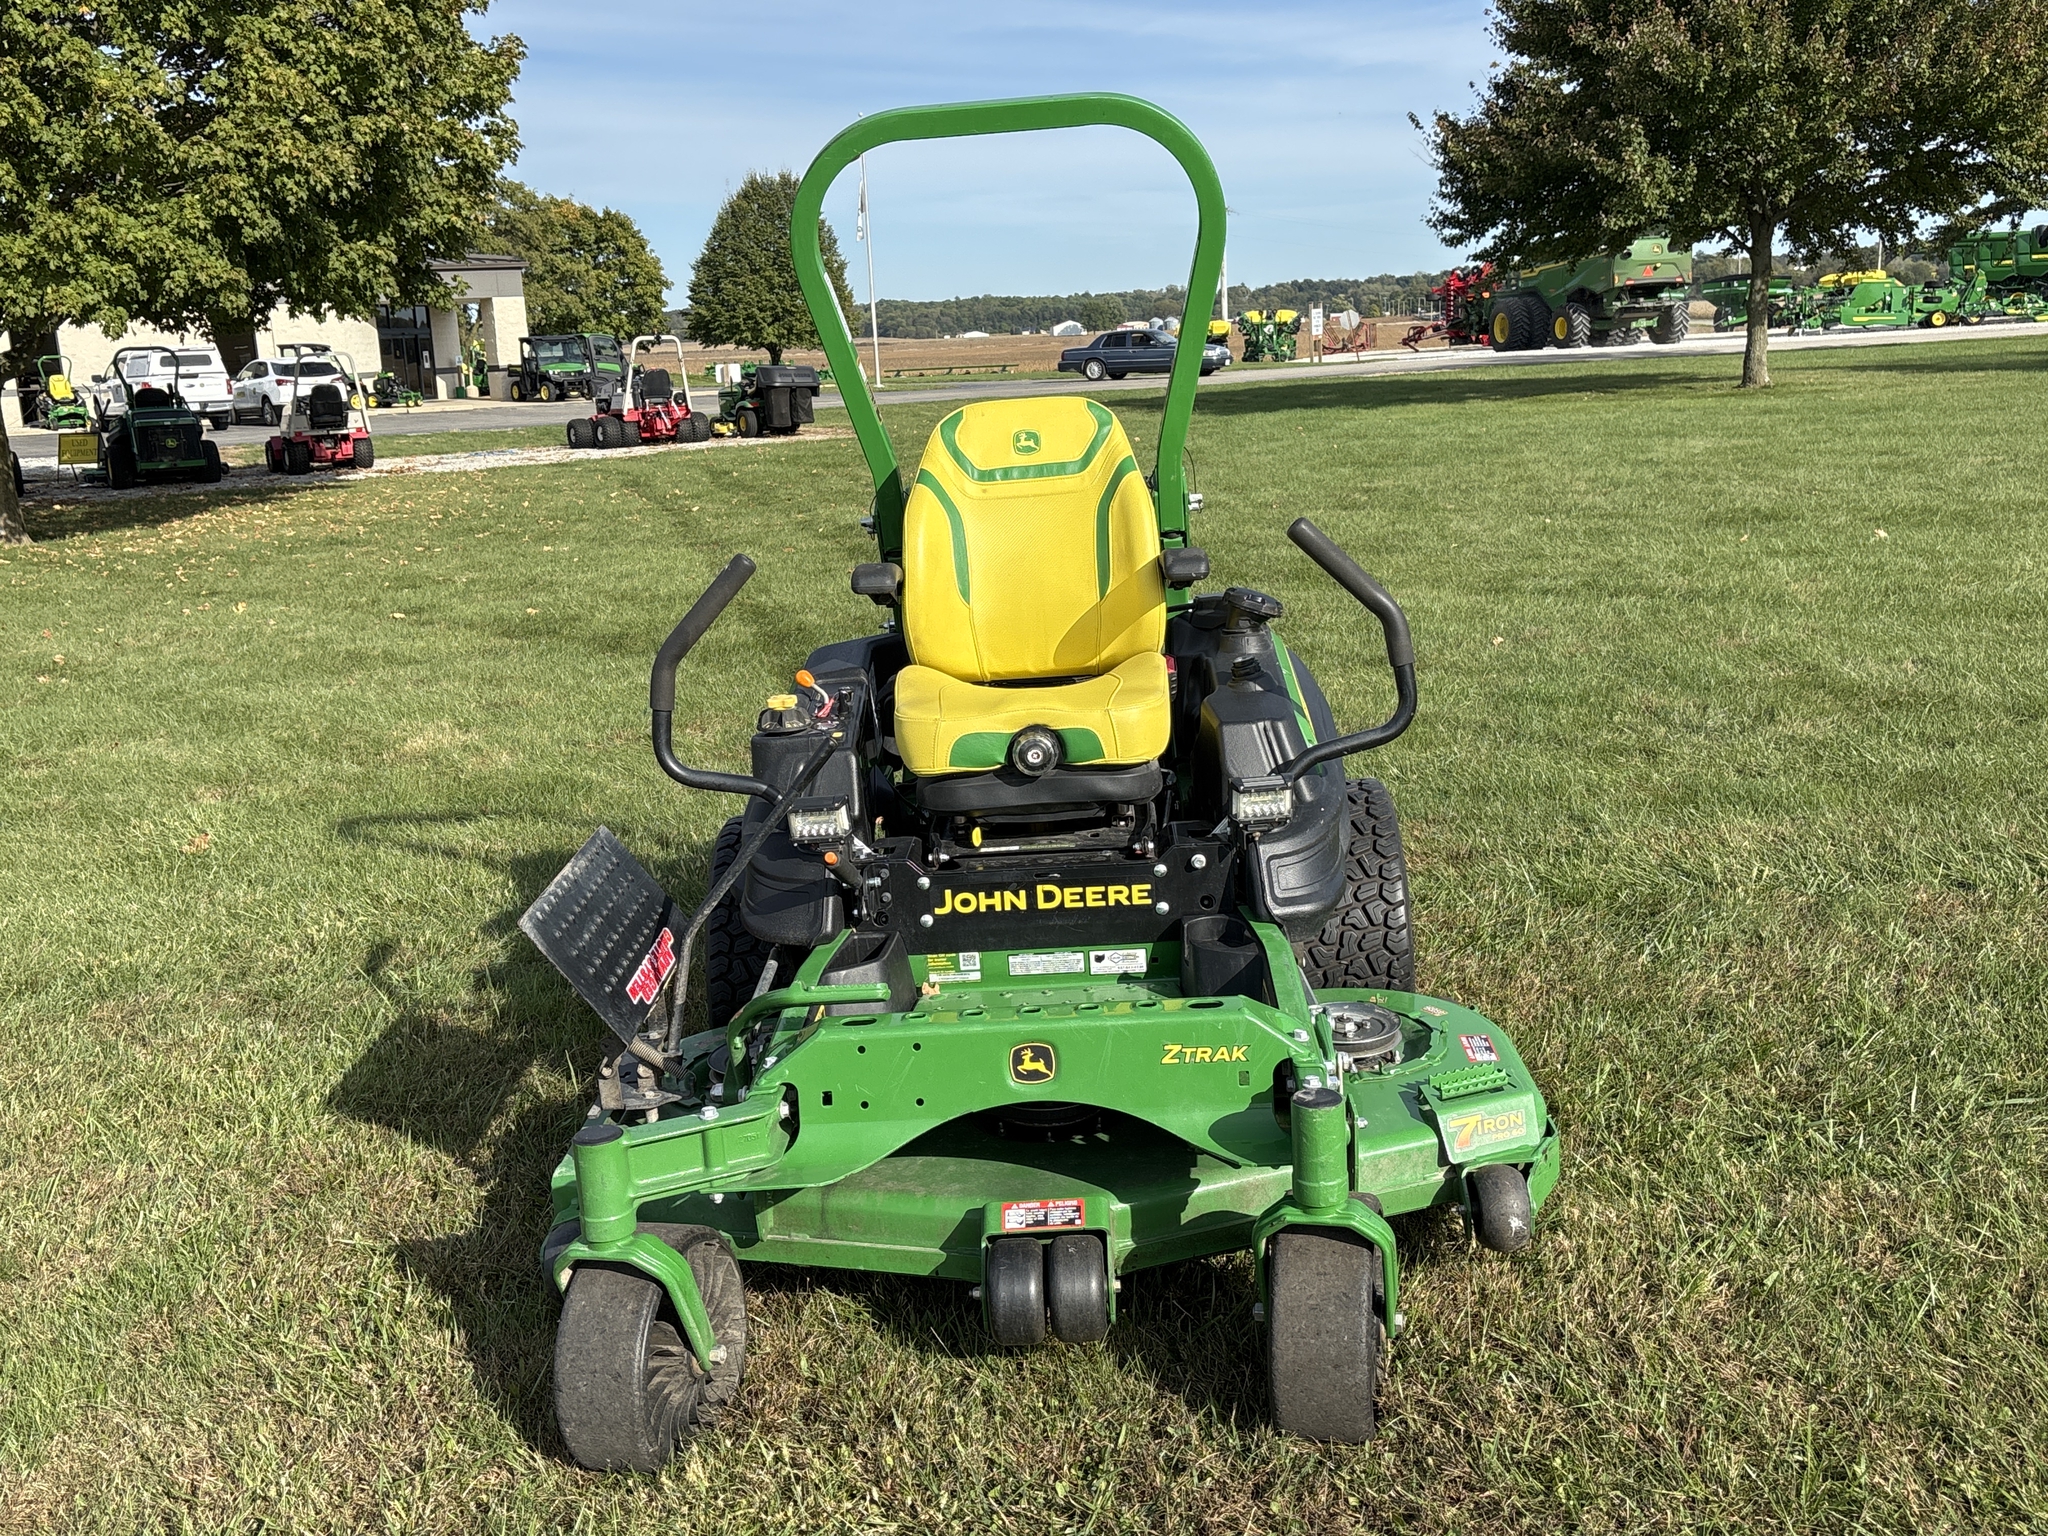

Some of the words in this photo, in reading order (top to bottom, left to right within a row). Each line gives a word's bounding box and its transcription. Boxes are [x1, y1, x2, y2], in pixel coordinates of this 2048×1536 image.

[71, 438, 88, 447] USED
[61, 448, 97, 458] EQUIPMENT
[934, 889, 1027, 915] JOHN
[1036, 883, 1153, 910] DEERE
[1161, 1043, 1251, 1065] ZTRAK
[1492, 1131, 1510, 1141] PRO
[1511, 1127, 1525, 1136] 60
